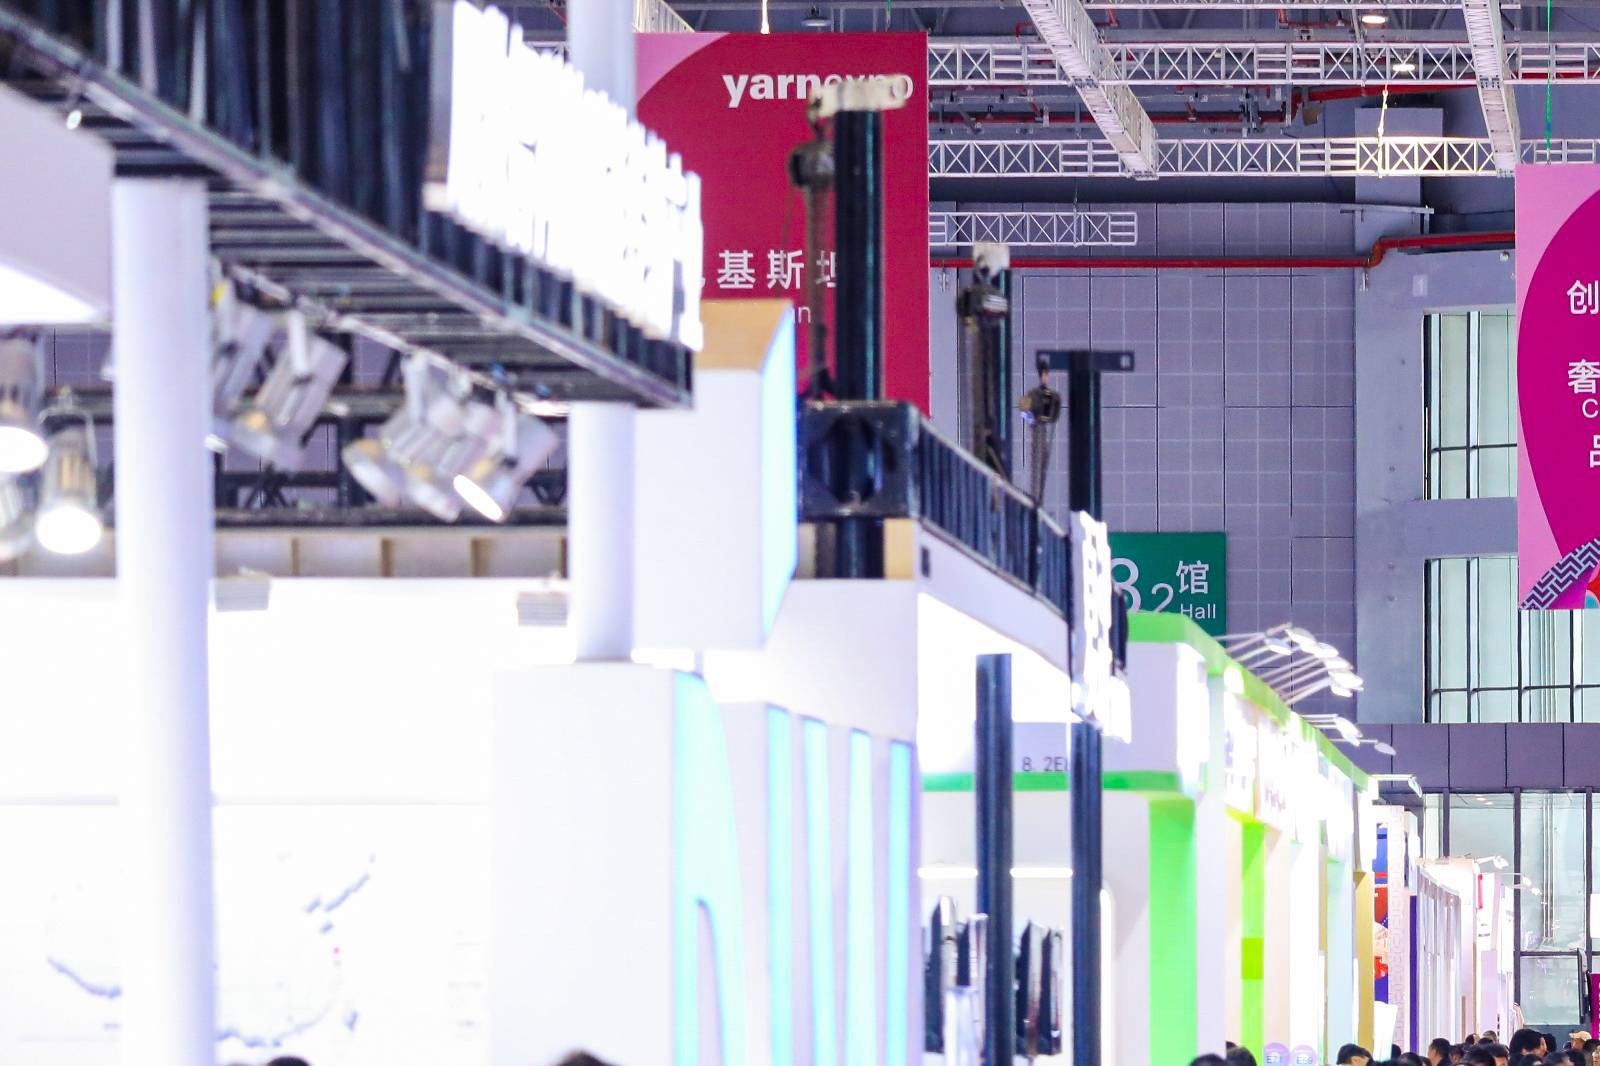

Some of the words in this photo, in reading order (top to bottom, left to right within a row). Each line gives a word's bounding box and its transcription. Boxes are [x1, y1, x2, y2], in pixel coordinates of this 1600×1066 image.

[722, 73, 914, 108] yarno
[701, 249, 836, 289] 基斯
[1180, 603, 1216, 619] Hall
